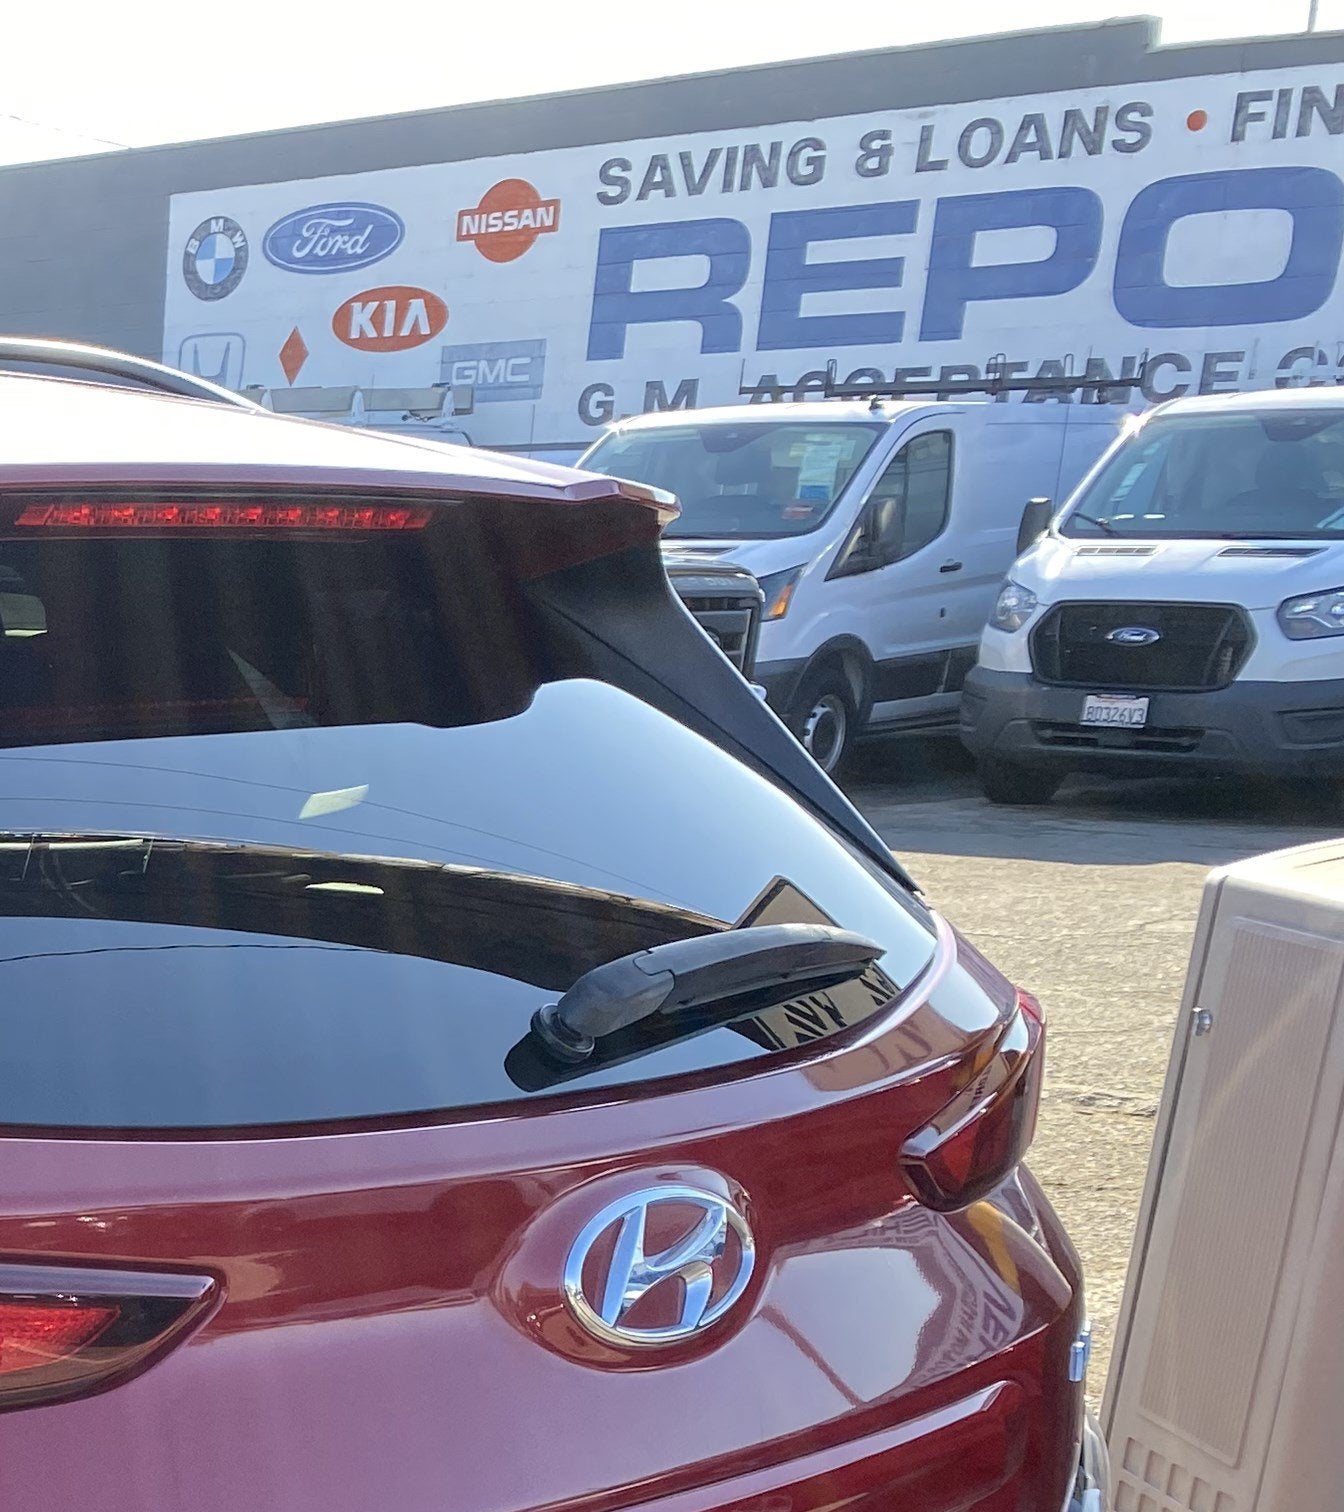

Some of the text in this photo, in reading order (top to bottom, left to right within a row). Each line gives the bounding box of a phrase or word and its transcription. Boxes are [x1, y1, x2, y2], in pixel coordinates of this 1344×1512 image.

[596, 83, 1344, 206] SAVING & LOANS FIN
[292, 217, 374, 259] Ford
[461, 206, 554, 237] NISSAN
[585, 165, 1344, 362] REPO
[348, 298, 432, 340] KIA
[452, 357, 532, 386] GMC
